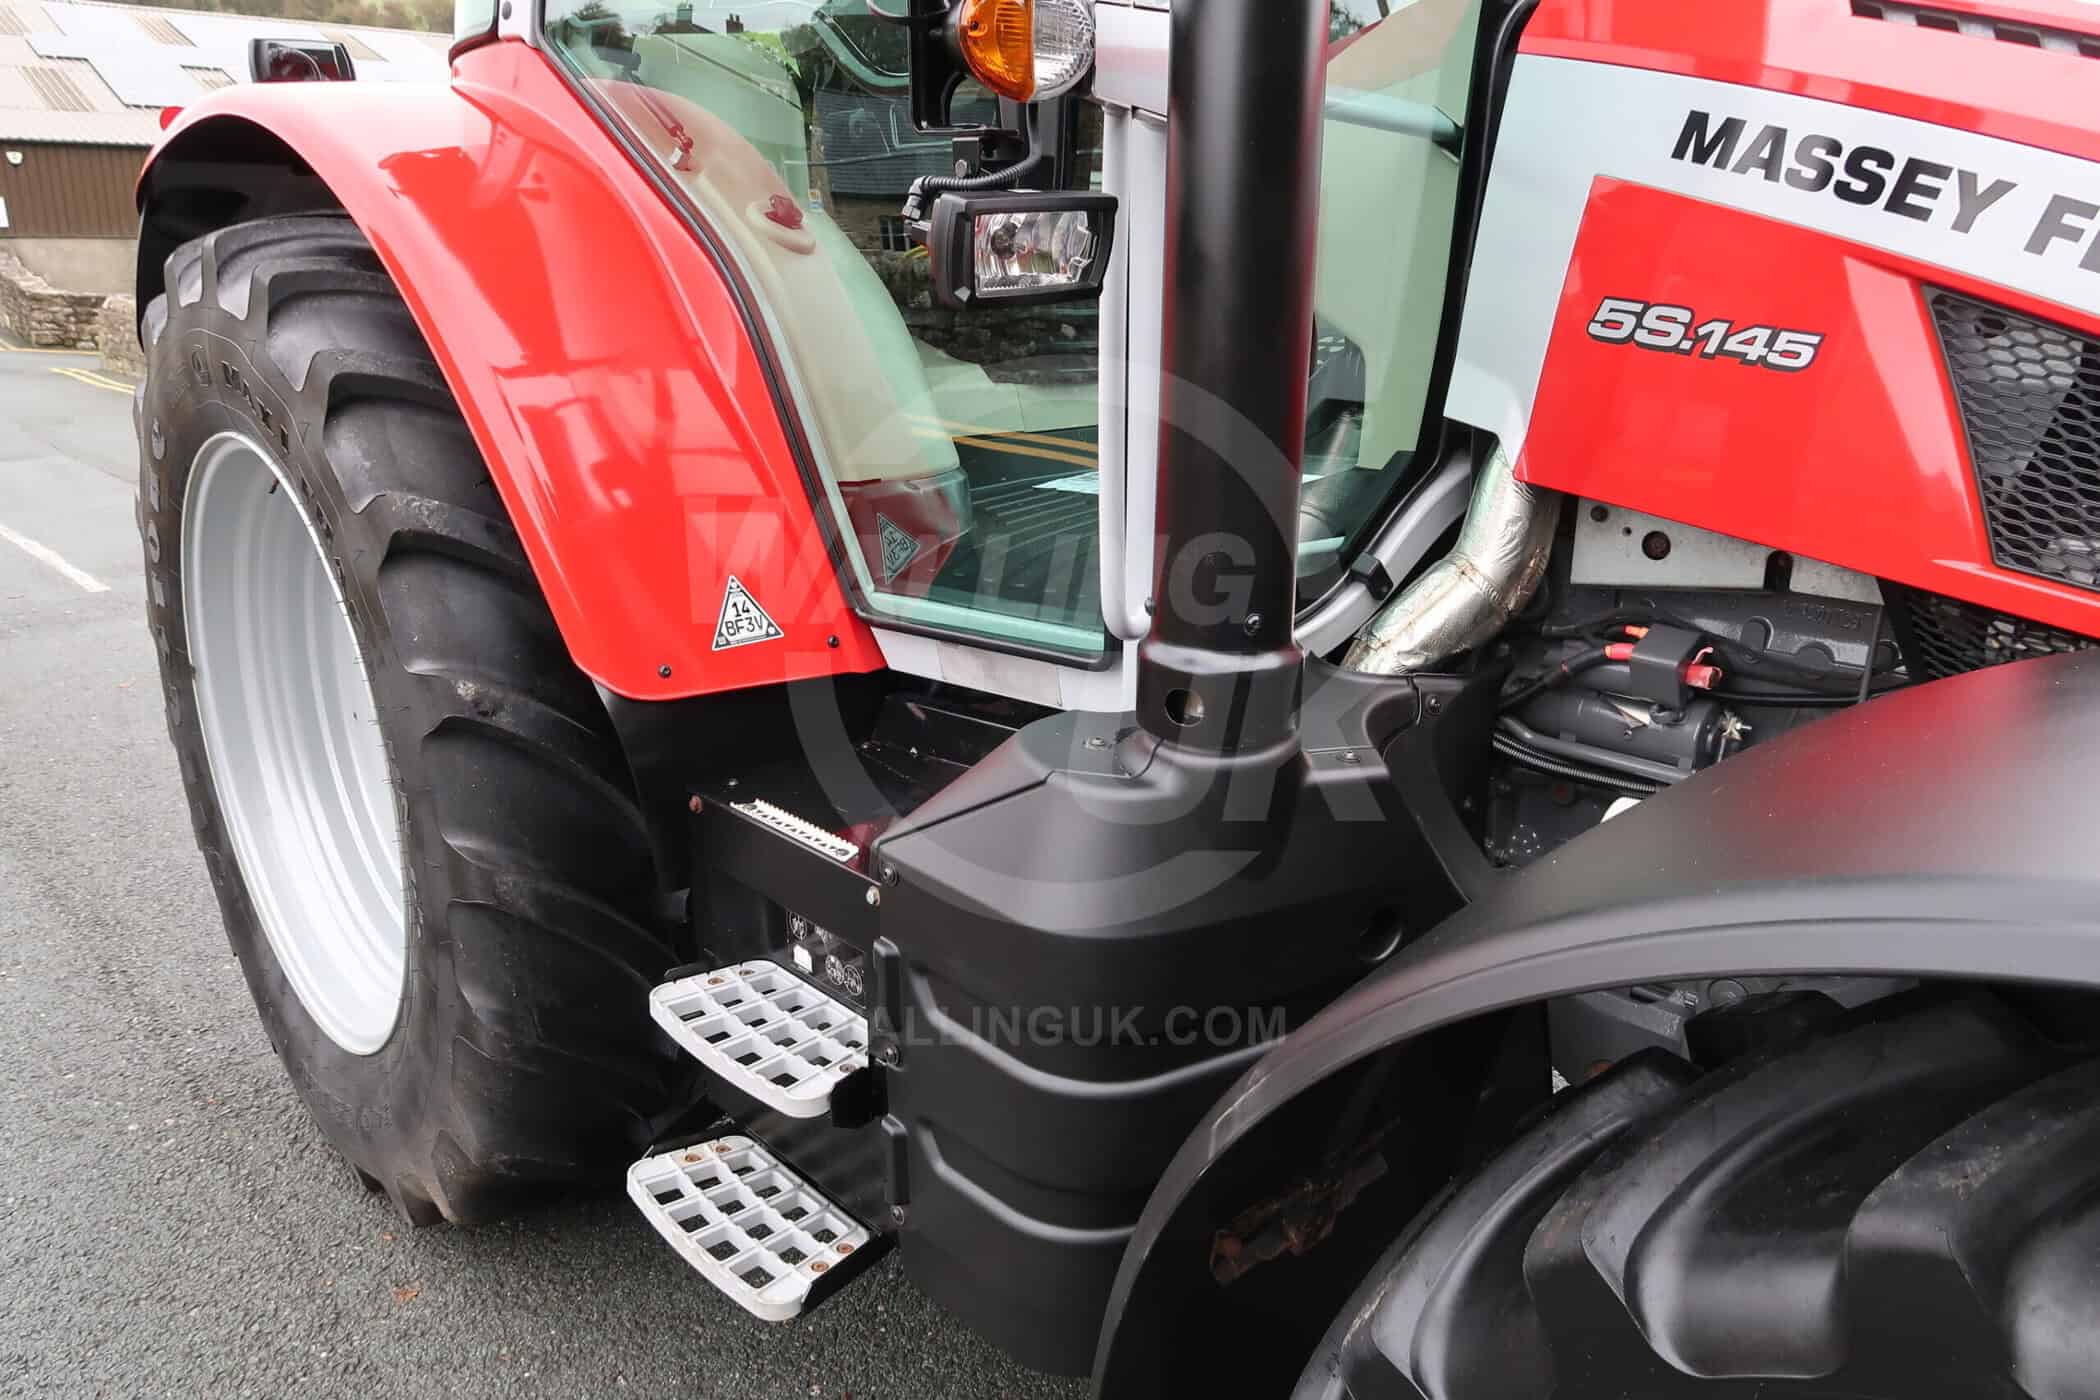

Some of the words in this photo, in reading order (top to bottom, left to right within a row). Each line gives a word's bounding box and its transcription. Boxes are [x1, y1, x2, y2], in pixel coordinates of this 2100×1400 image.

[1671, 109, 2018, 234] MASSEY
[1586, 296, 1824, 371] 5S.145
[725, 614, 763, 636] BF3V
[731, 600, 750, 617] 14
